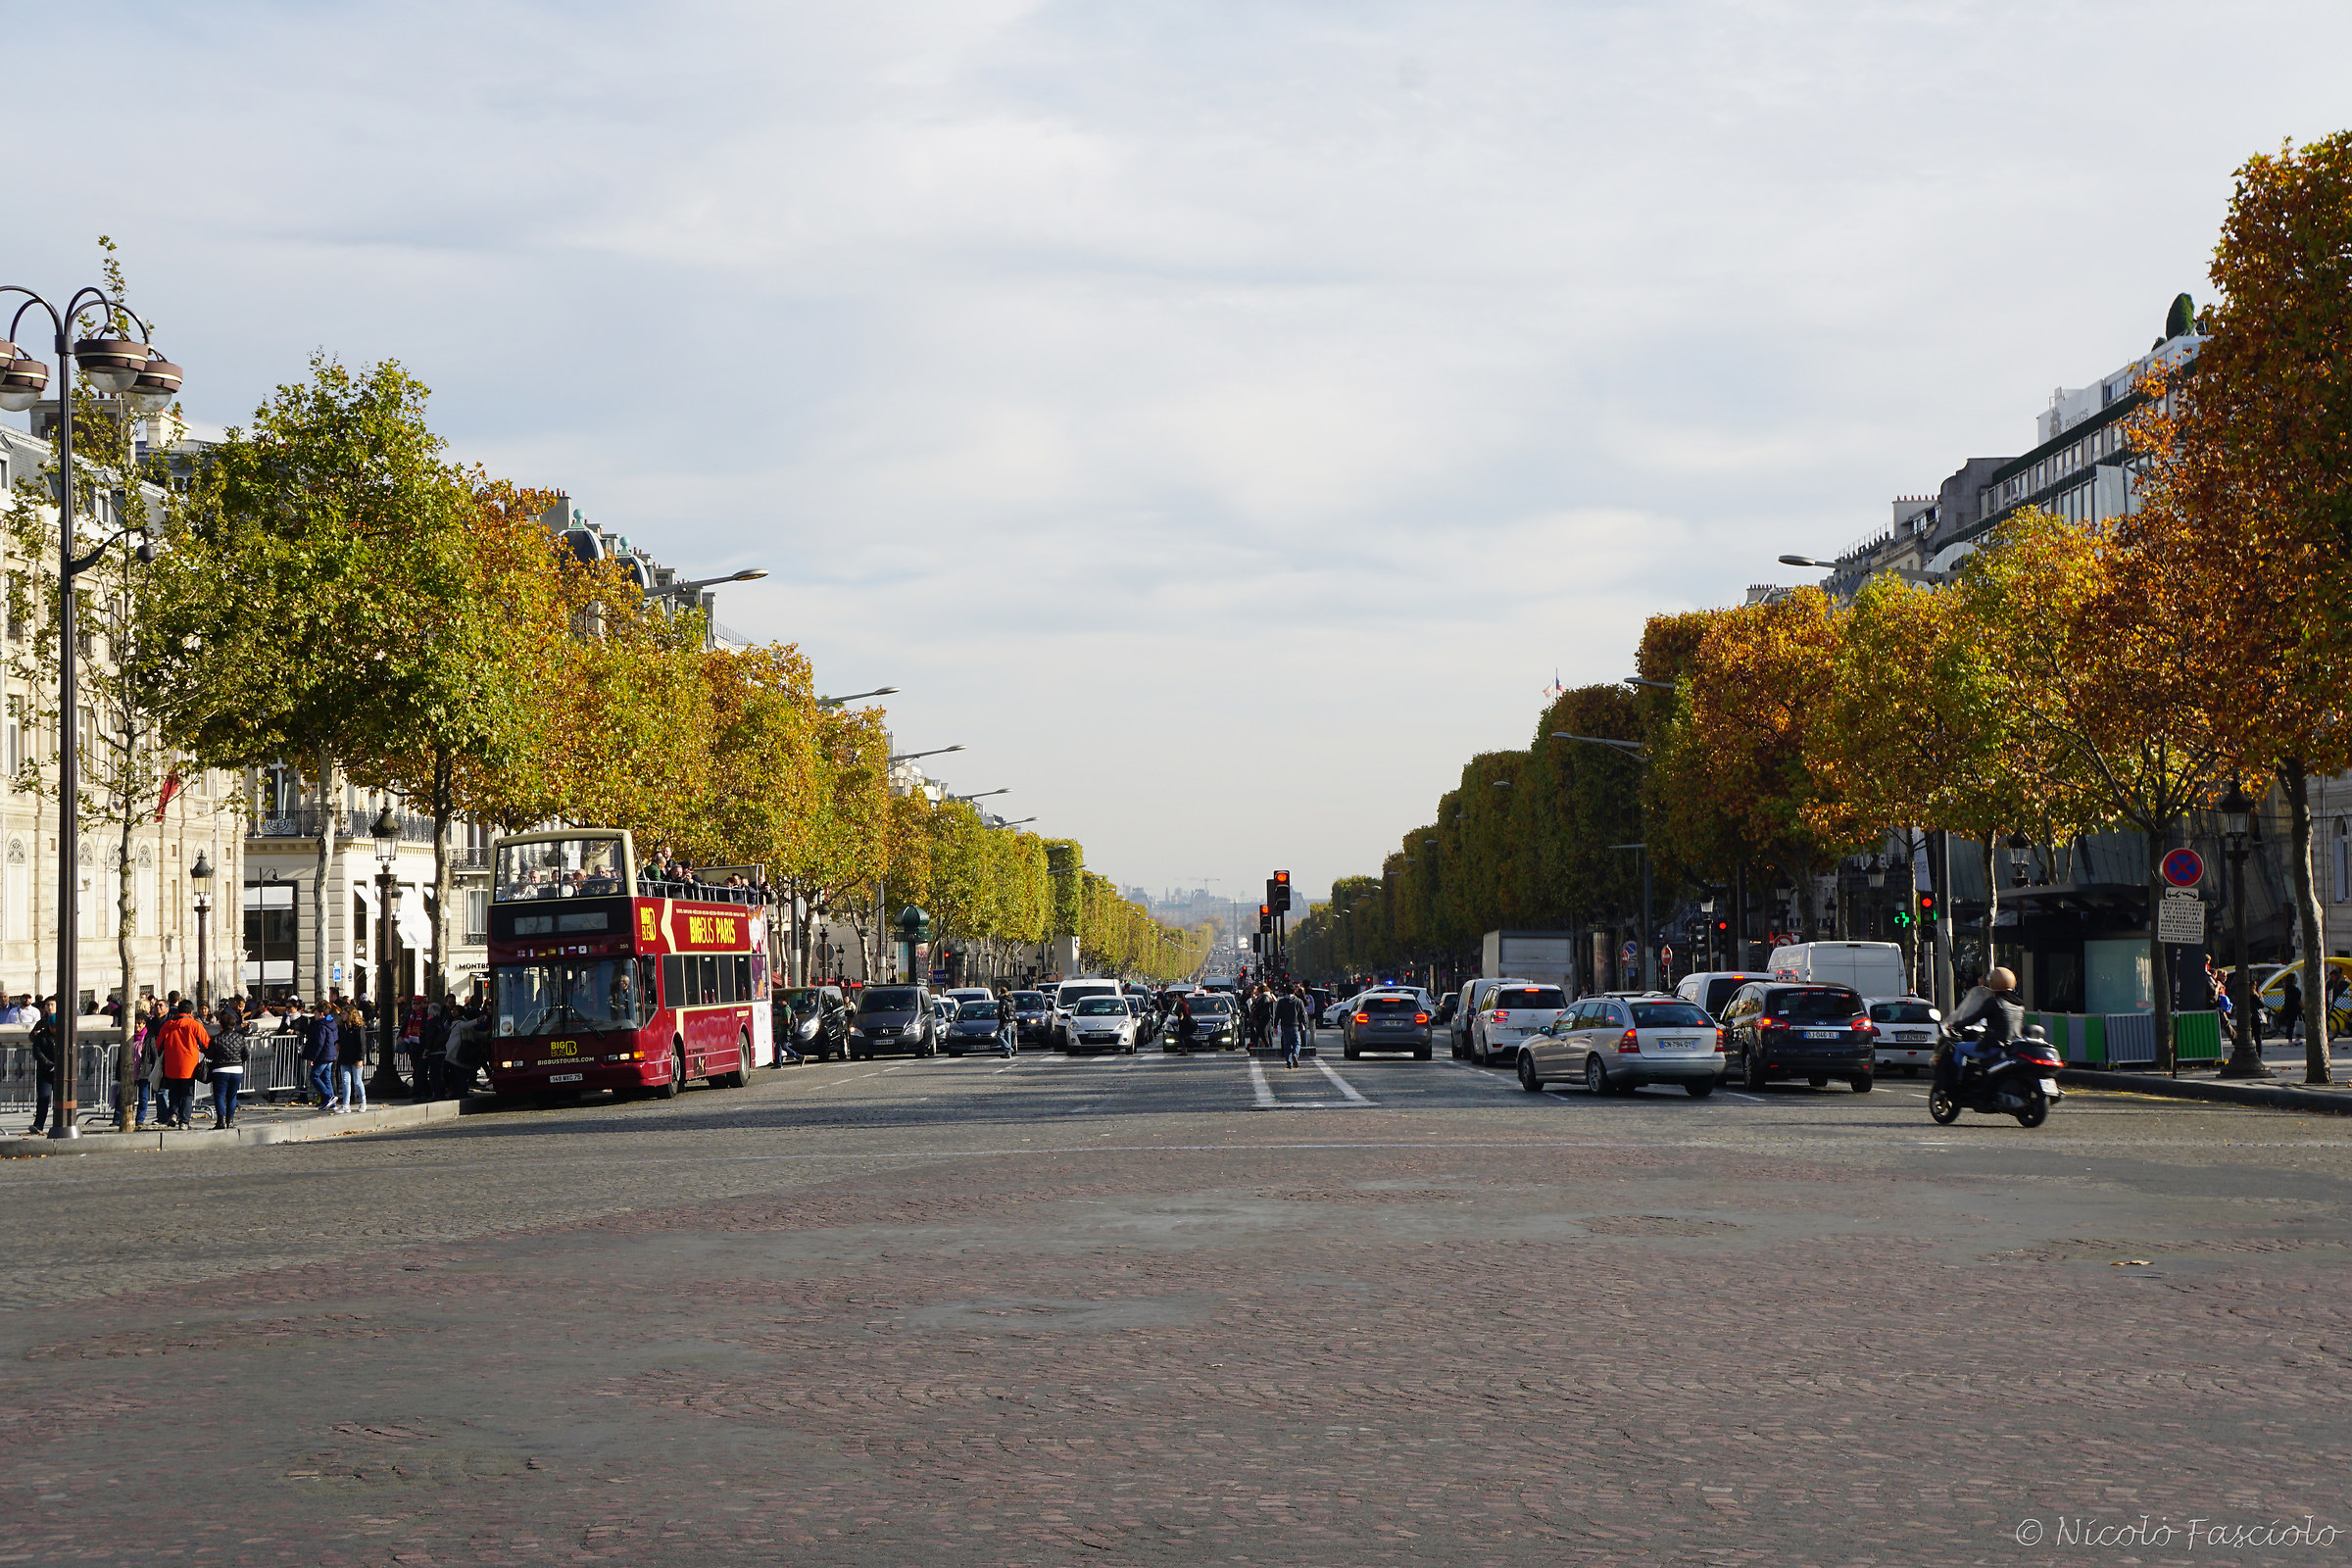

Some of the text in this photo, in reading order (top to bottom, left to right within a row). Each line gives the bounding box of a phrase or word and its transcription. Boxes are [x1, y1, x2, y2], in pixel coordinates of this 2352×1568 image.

[2065, 409, 2088, 430] PUBLICIS
[715, 917, 735, 944] PARIS
[551, 1049, 566, 1057] BUS
[538, 1056, 594, 1066] BIGBUSTOURS.COM
